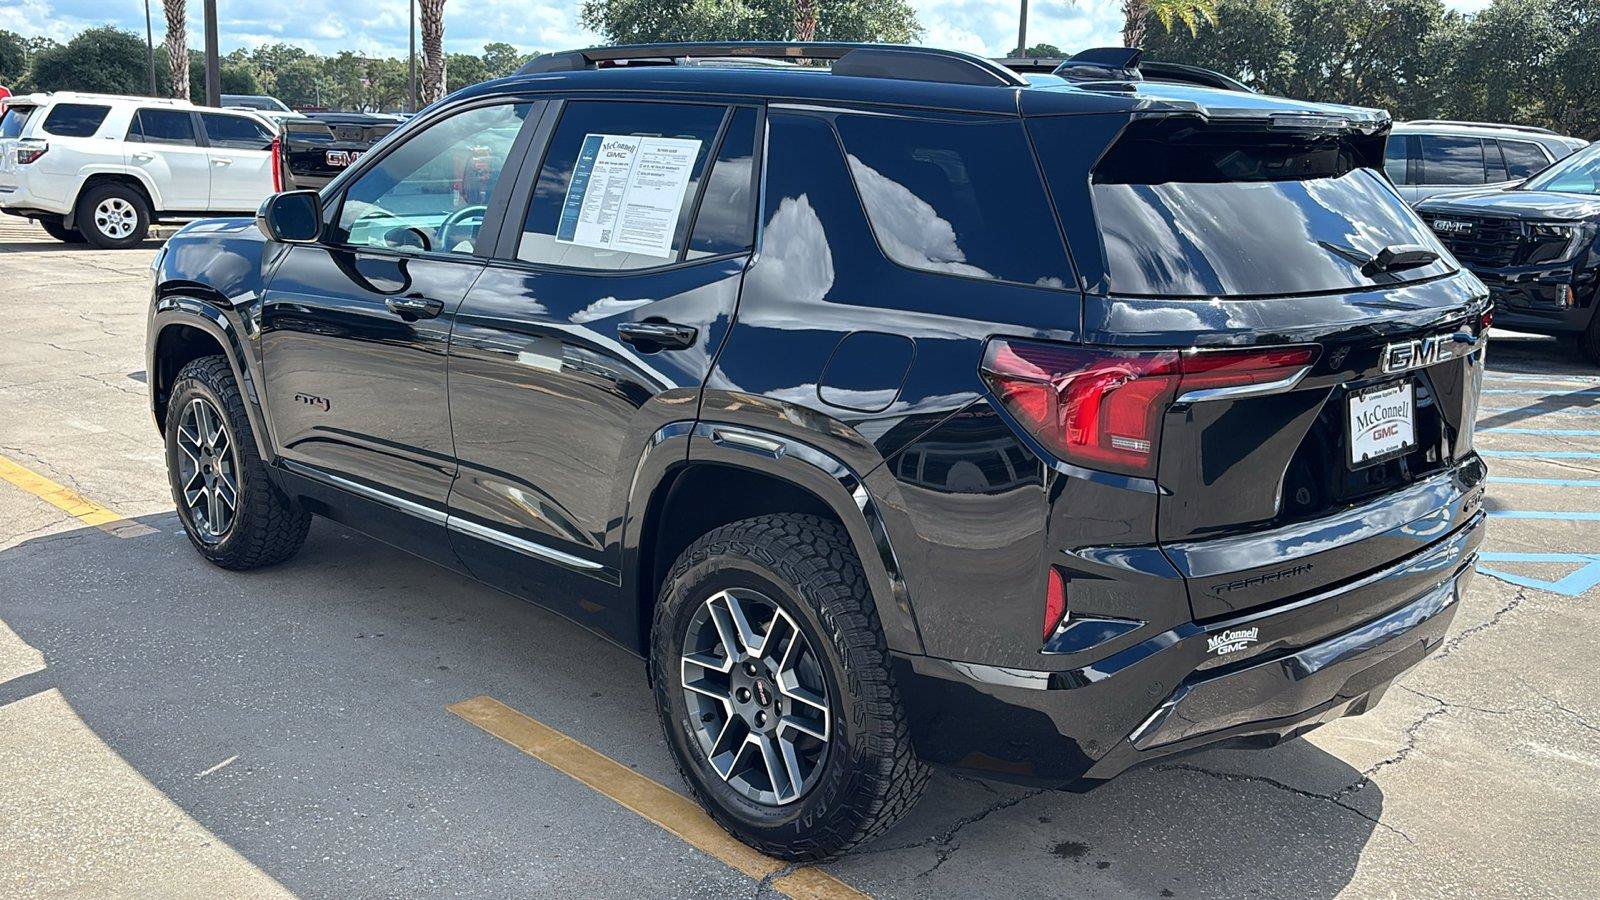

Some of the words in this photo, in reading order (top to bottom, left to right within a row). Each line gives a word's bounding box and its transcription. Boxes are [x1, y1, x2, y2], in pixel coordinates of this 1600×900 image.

[602, 141, 636, 154] McConnell
[606, 151, 628, 159] GMC
[326, 150, 366, 167] GM
[1433, 219, 1473, 234] GMC
[1383, 334, 1455, 374] GMC
[1355, 401, 1409, 432] McConnell
[1373, 423, 1399, 441] GMC
[1206, 627, 1259, 650] McConnell
[1217, 641, 1248, 655] GMC
